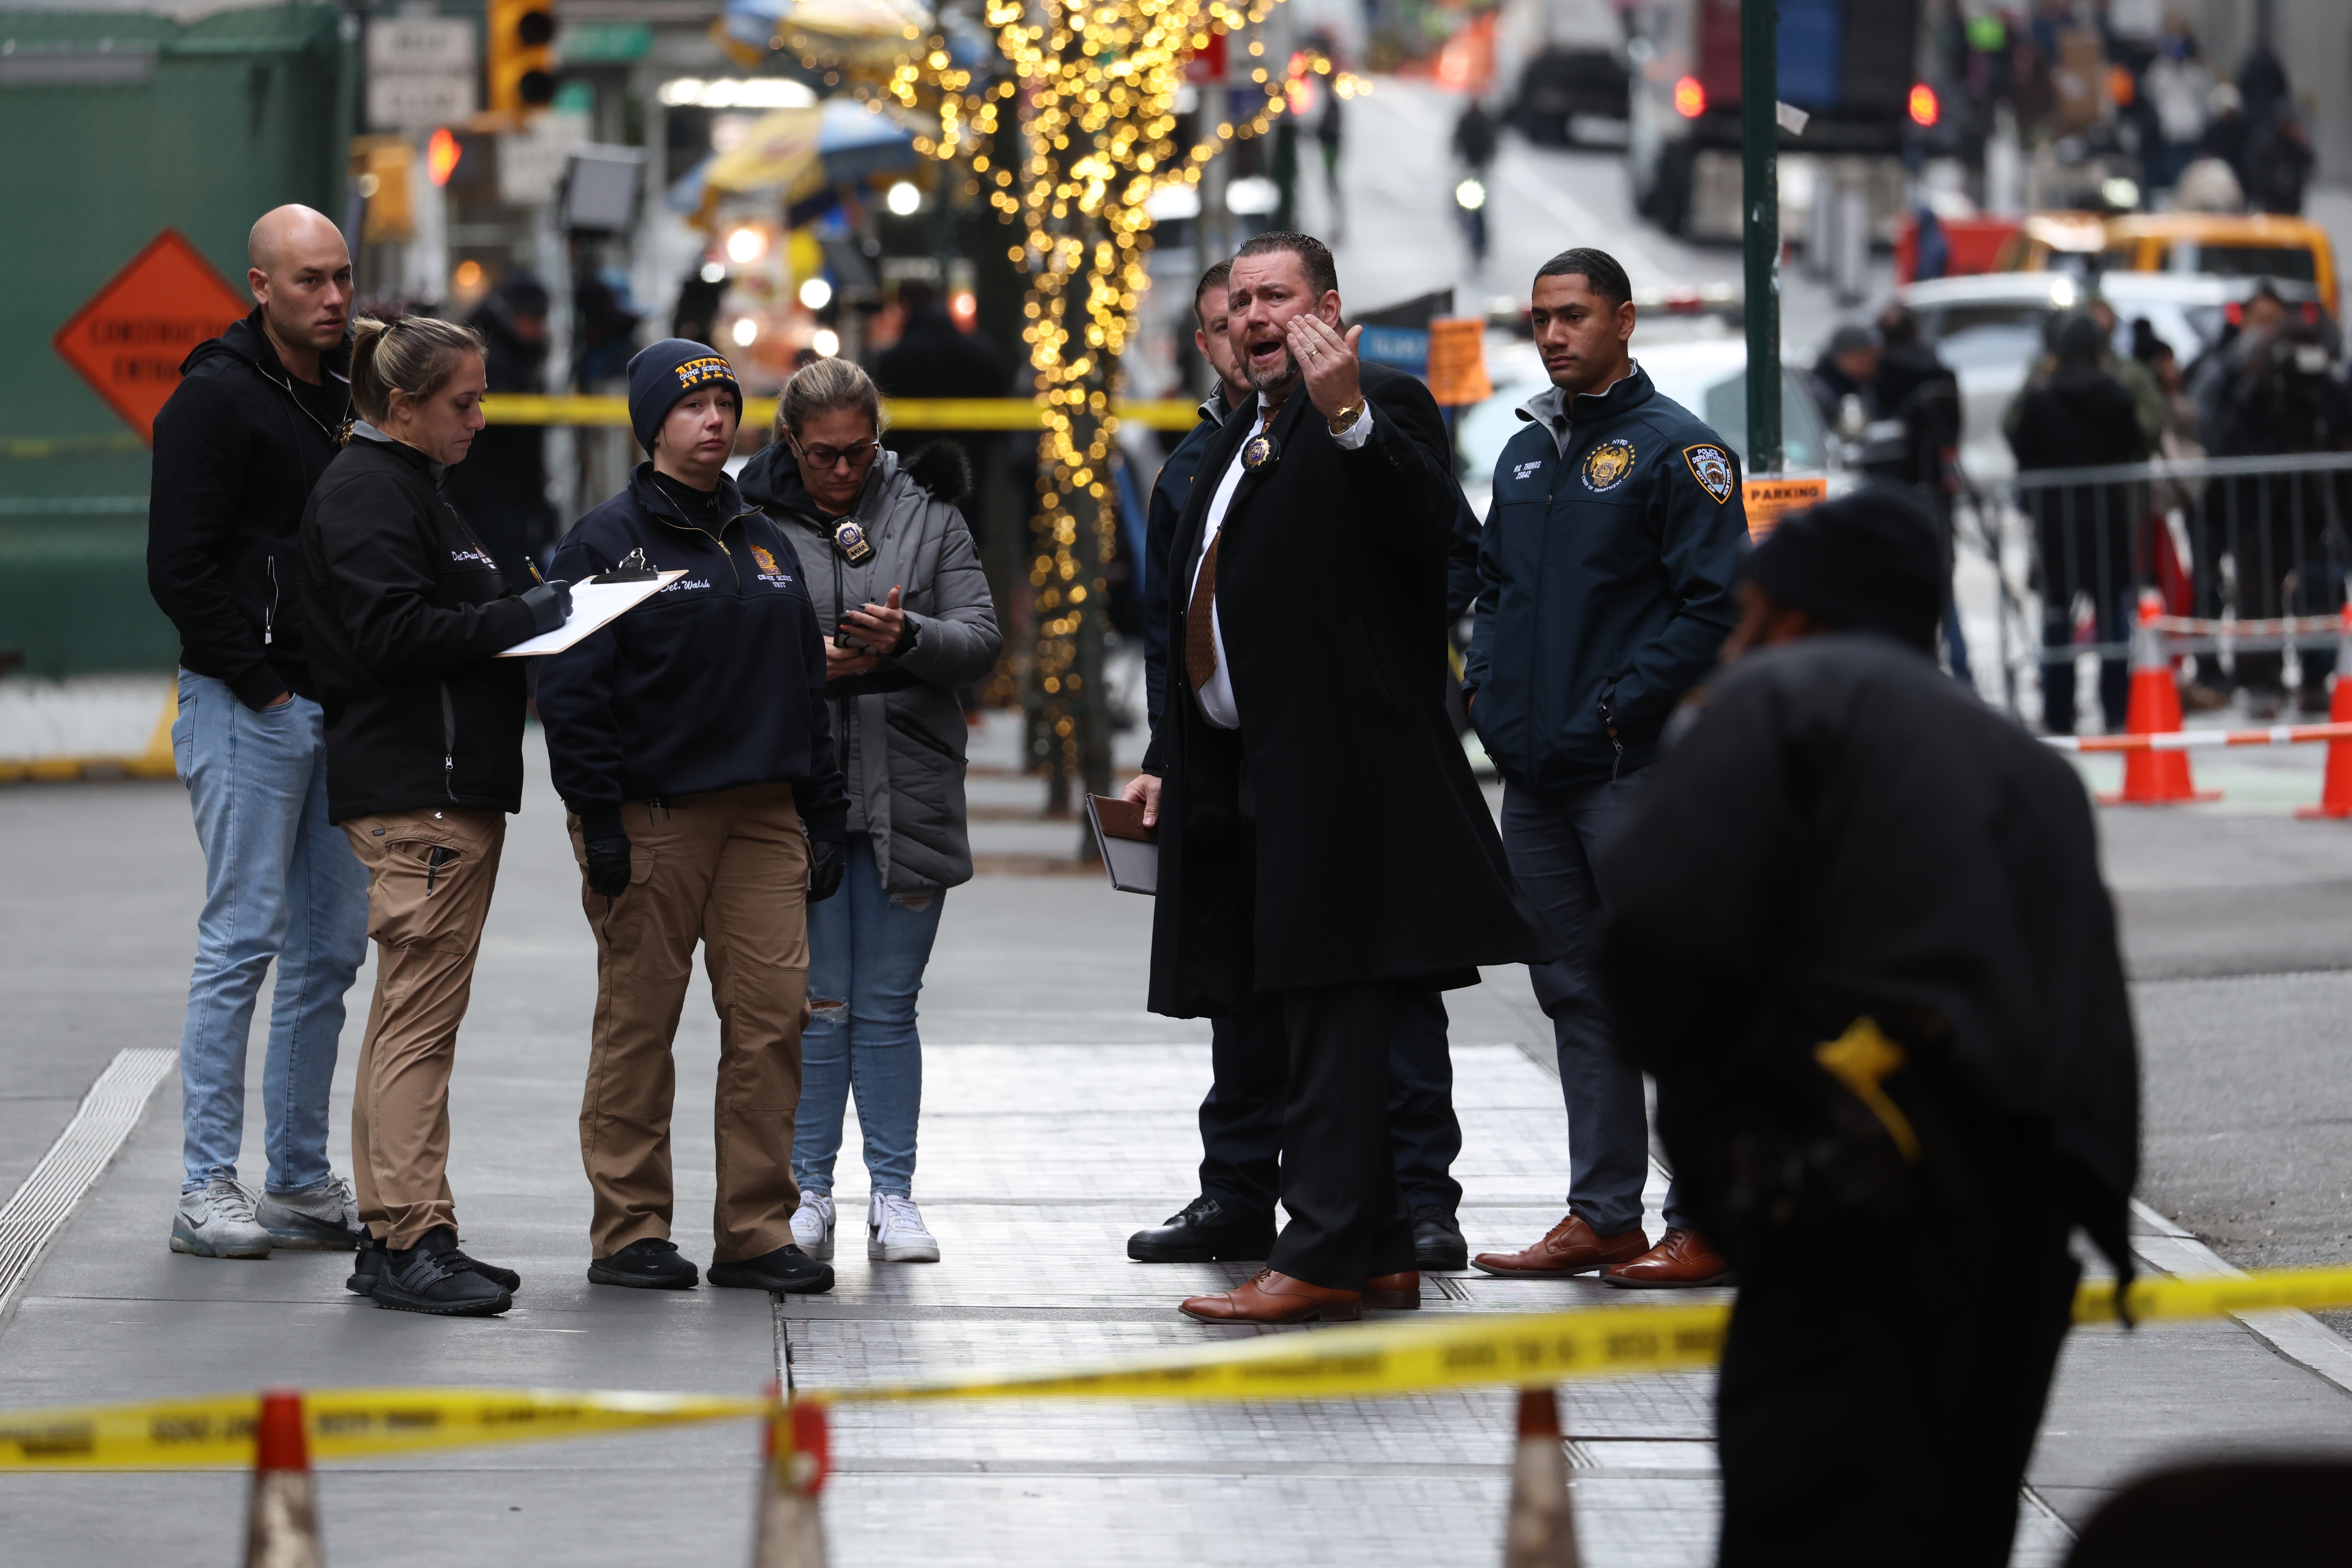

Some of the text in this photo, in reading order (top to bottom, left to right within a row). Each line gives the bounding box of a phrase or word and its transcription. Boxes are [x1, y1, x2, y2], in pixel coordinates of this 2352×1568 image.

[675, 358, 735, 388] NYPD
[679, 368, 700, 381] CRIME
[1523, 461, 1541, 471] THOMAS
[1692, 454, 1726, 465] DEPARTMENT
[1515, 470, 1532, 479] 25642
[1594, 479, 1622, 492] DEPARTMENT
[1696, 470, 1716, 493] CITY OF
[1751, 486, 1818, 500] PARKING
[681, 579, 710, 590] Walsh
